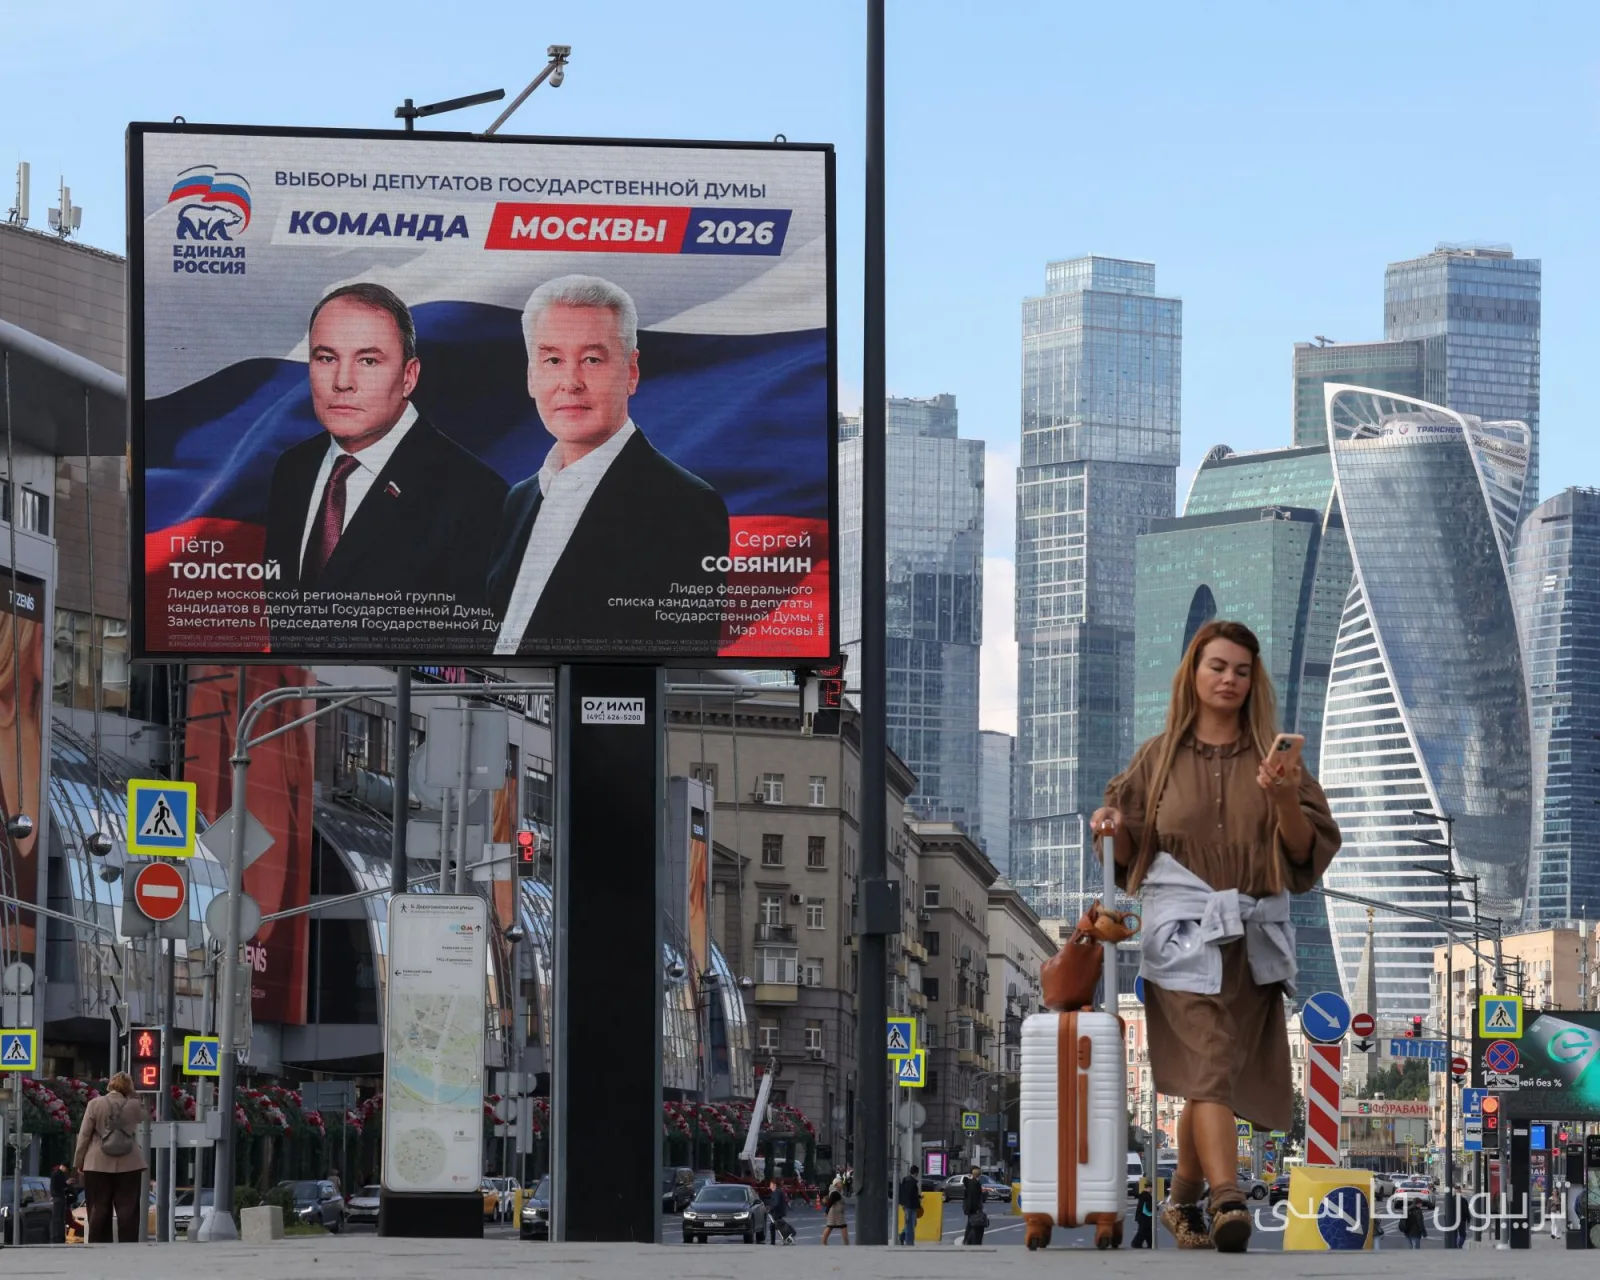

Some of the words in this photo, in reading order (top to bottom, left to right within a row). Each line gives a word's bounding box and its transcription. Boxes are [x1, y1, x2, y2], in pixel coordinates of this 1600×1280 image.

[275, 171, 367, 188] ВЫБОРЫ
[372, 174, 493, 192] ДЕПУТАТОВ
[499, 176, 698, 197] ГОСУДАРСТВЕННОЙ
[704, 182, 766, 200] ДУМЫ
[288, 210, 470, 242] КОМАНДА
[510, 216, 667, 243] МОСКВЫ
[696, 220, 775, 245] 2026
[173, 244, 246, 260] ЕДИНАЯ
[173, 260, 246, 275] РОССИЯ
[170, 536, 225, 557] Пётр
[735, 530, 811, 551] Сергей
[169, 560, 281, 580] ТОЛСТОЙ
[701, 555, 812, 574] СОБЯНИН
[167, 587, 213, 603] Лидер
[216, 589, 299, 602] московской
[303, 590, 402, 605] региональной
[406, 592, 457, 606] группы
[669, 583, 713, 596] Лидер
[716, 583, 813, 596] федерального
[167, 603, 249, 616] кандидатов
[253, 605, 261, 615] в
[263, 604, 329, 619] депутаты
[332, 604, 450, 620] Государственной
[452, 606, 495, 621] Думы,
[607, 597, 655, 608] списка
[658, 597, 736, 610] кандидатов
[740, 599, 748, 608] в
[751, 599, 813, 612] депутаты
[167, 615, 257, 629] Заместитель
[260, 616, 359, 632] Председателя
[361, 618, 480, 632] Государственной
[655, 609, 770, 623] Государственной
[772, 610, 813, 624] Думы,
[729, 624, 757, 638] Мэр
[761, 625, 813, 636] Москвы
[1536, 1078, 1552, 1087] без
